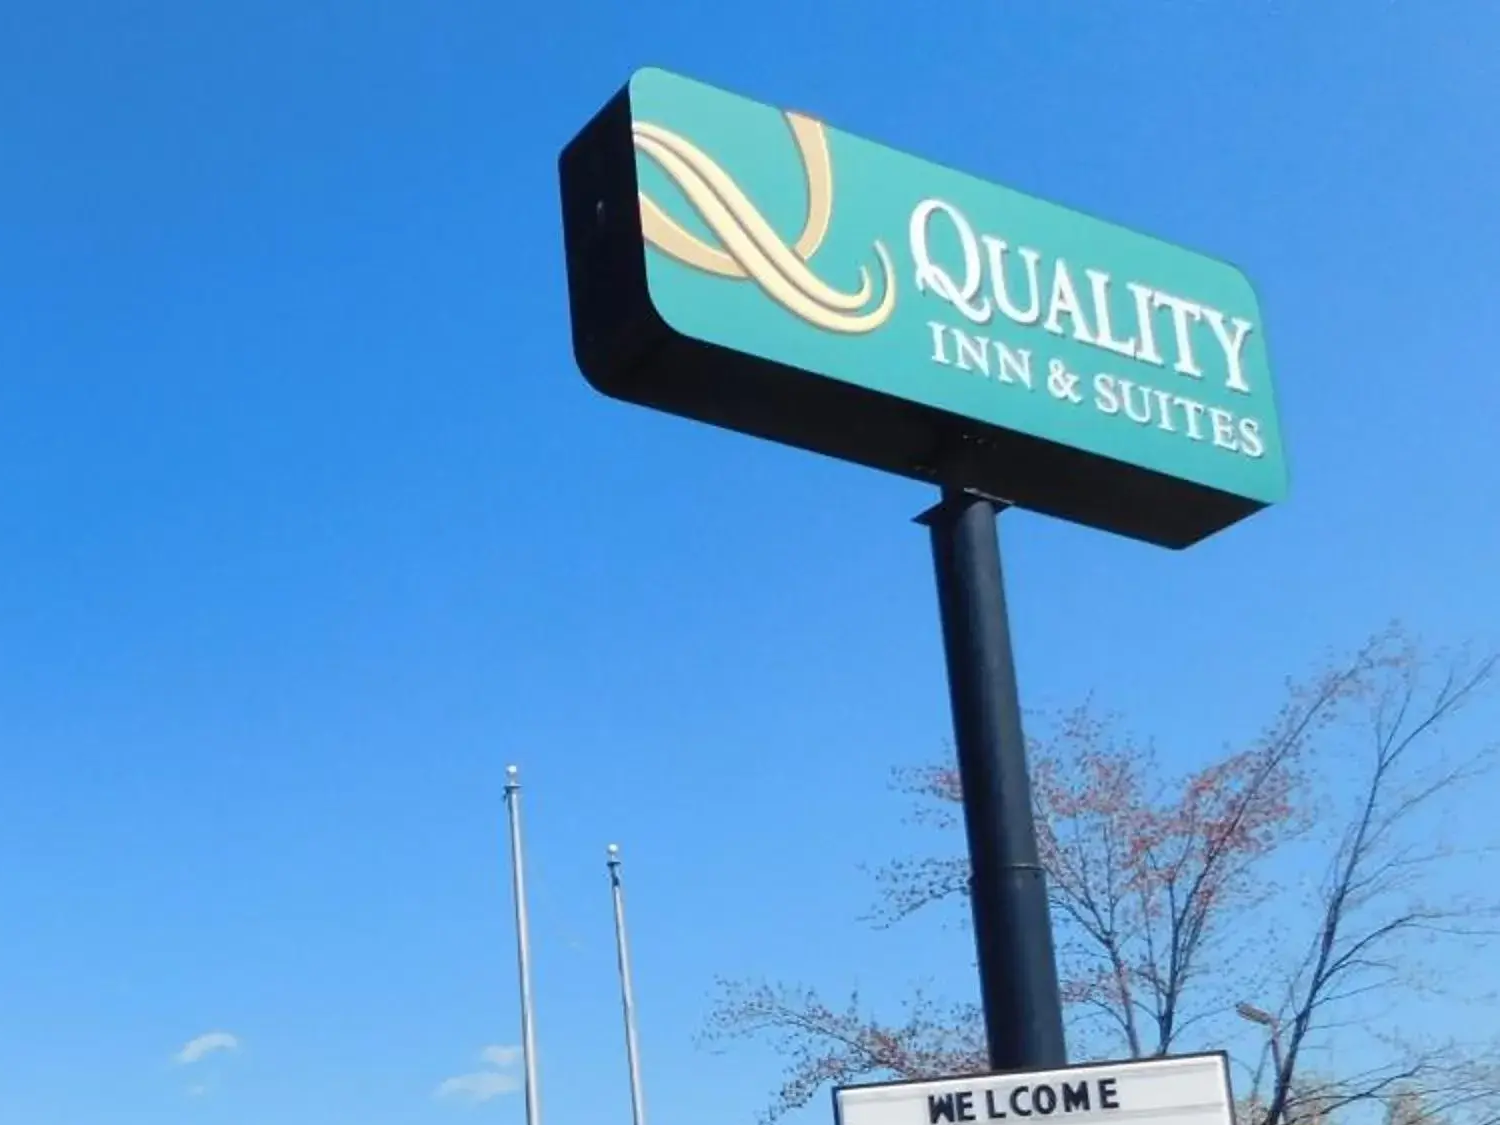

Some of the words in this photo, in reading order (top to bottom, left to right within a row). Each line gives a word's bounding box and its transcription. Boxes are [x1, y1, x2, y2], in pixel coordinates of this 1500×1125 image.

[909, 199, 1251, 393] QUALITY
[927, 321, 1032, 389] INN
[1047, 358, 1083, 404] &
[1093, 373, 1264, 458] SUITES
[928, 1078, 1119, 1124] WELCOME
